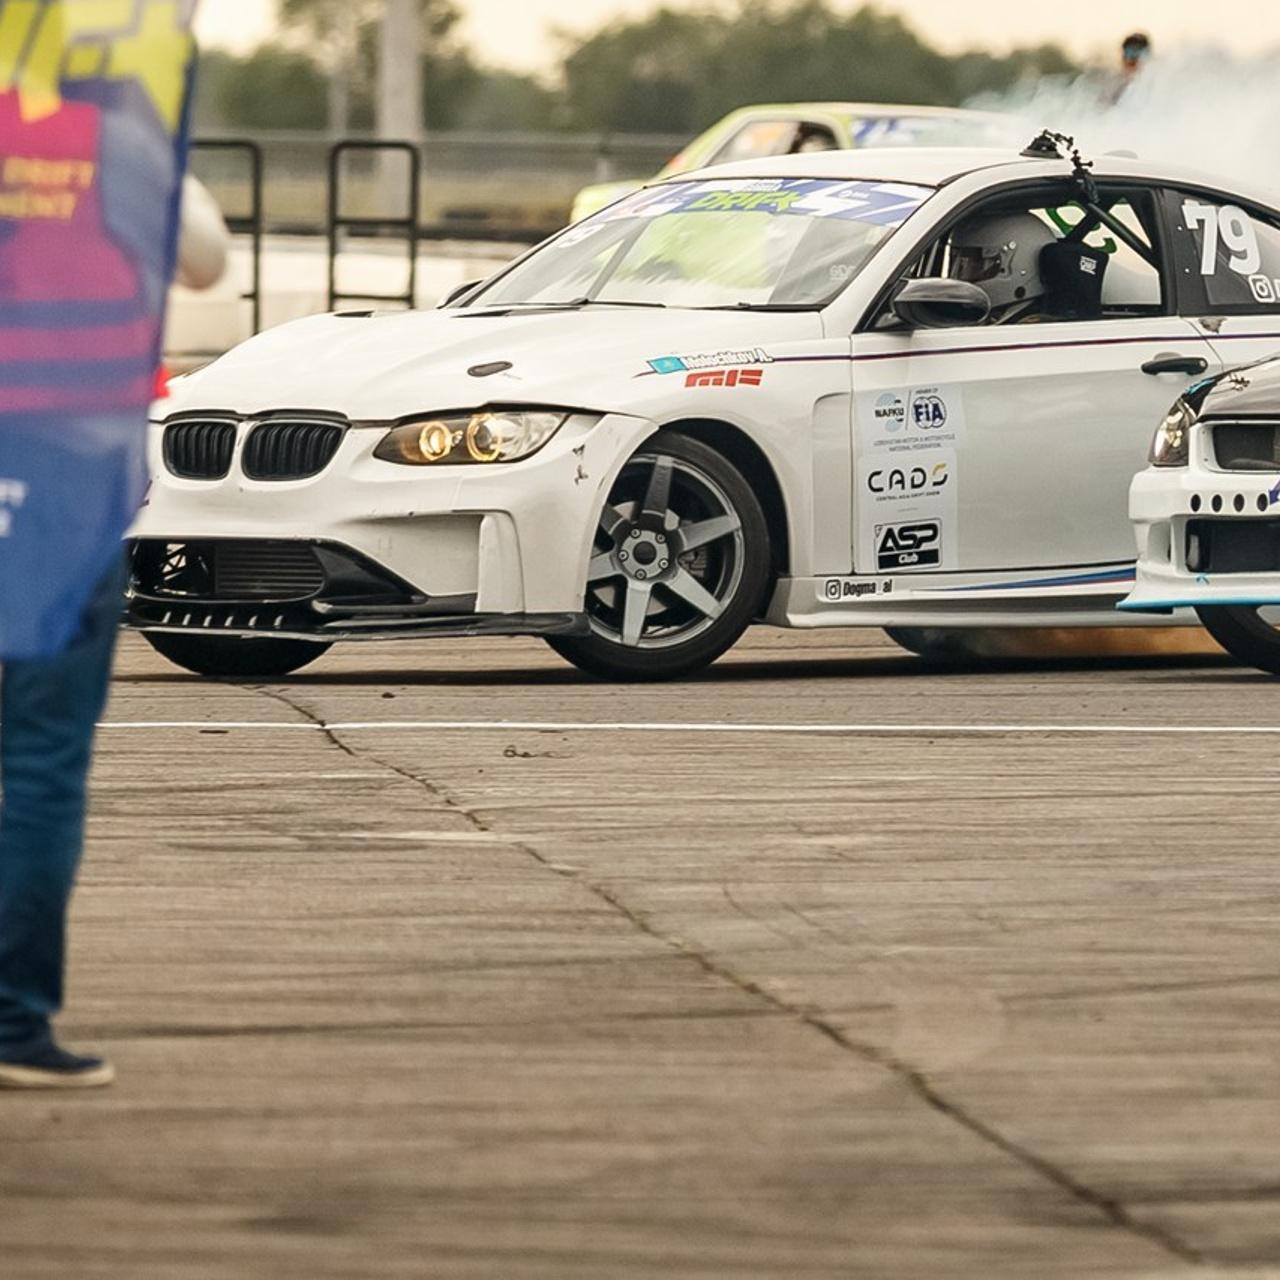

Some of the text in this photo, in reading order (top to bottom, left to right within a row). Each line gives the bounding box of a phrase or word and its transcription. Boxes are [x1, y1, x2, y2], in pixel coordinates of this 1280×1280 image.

[1181, 199, 1261, 275] 79
[867, 463, 948, 492] CADS
[877, 522, 939, 553] ASP
